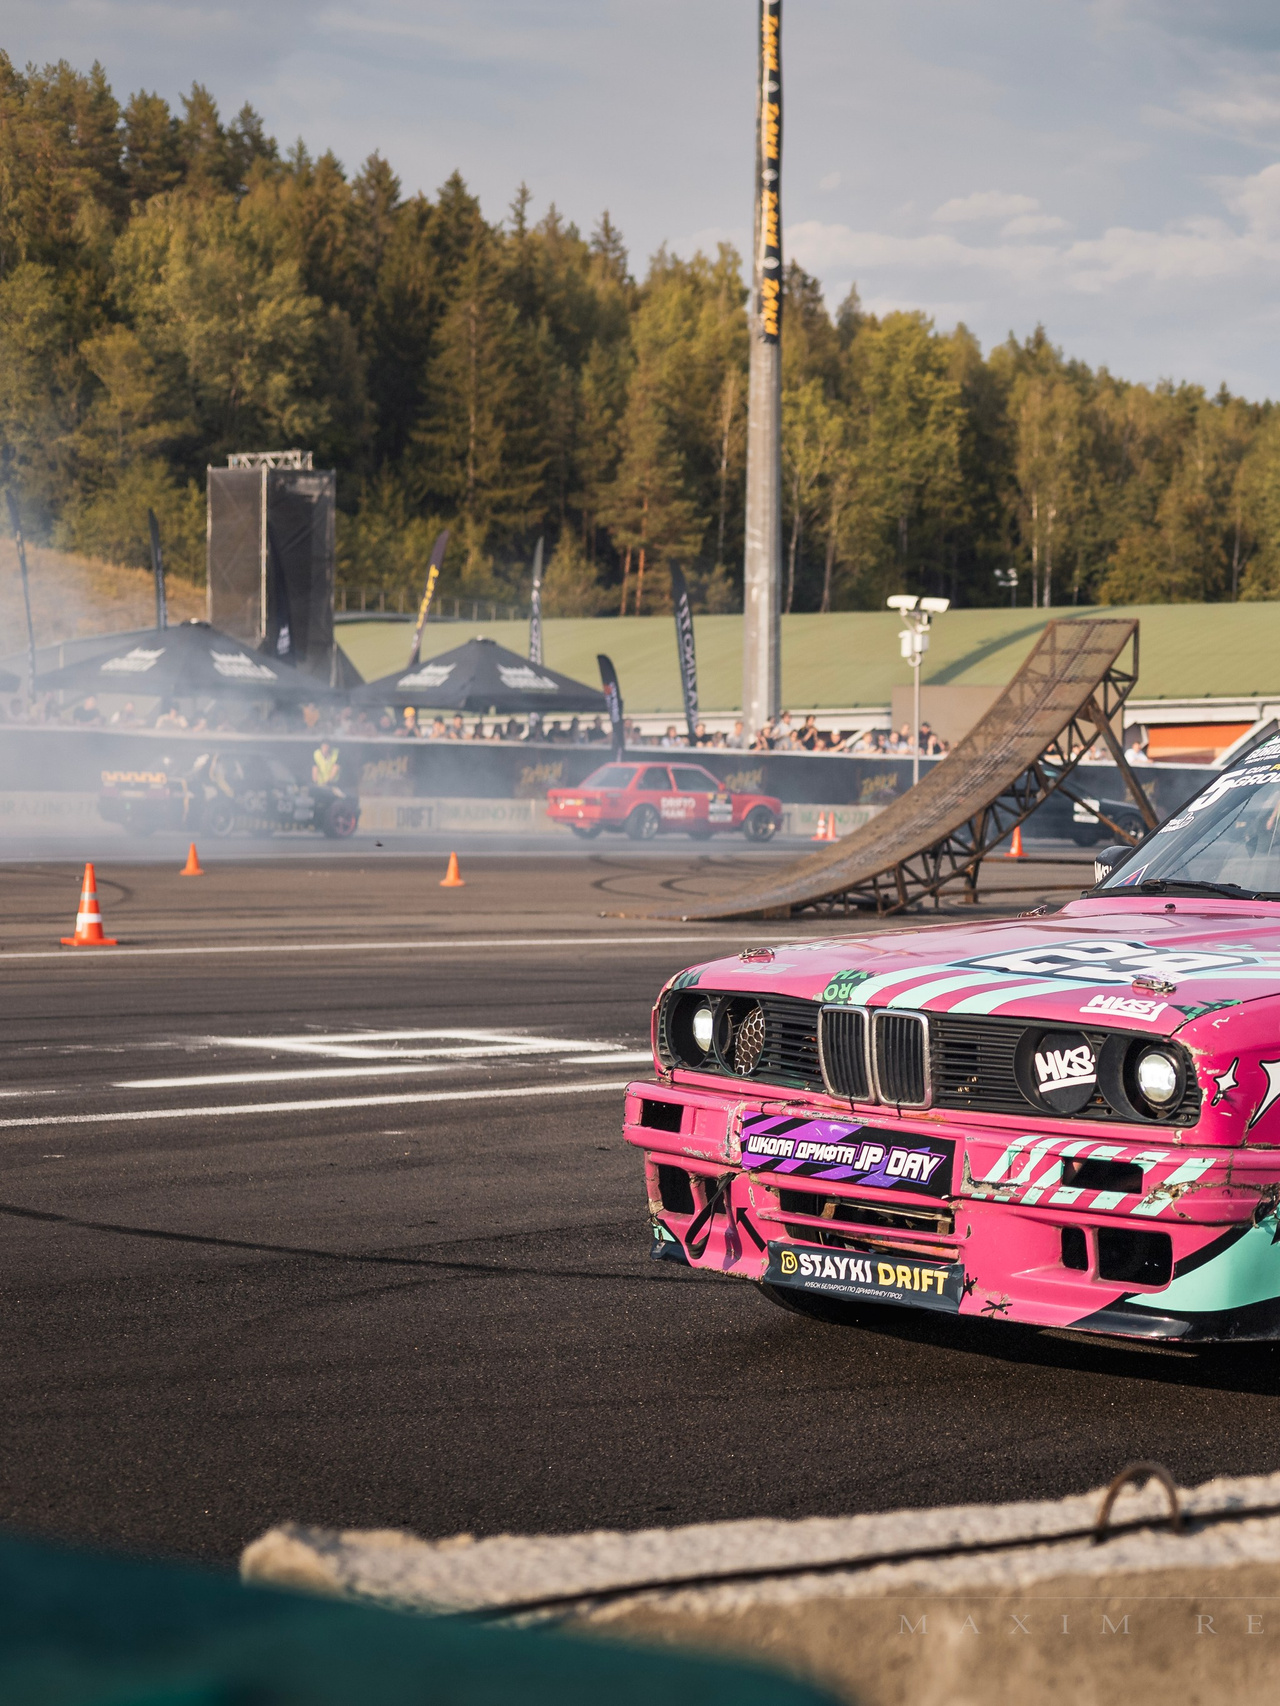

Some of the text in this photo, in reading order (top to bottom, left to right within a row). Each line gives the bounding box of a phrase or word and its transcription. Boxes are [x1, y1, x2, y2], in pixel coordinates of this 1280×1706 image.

[1188, 768, 1247, 812] 5
[1245, 764, 1270, 774] CUP
[747, 1135, 940, 1181] ШКОЛА ДРИФТА JP DAY
[799, 1253, 949, 1295] STAYKI DRIFT
[804, 1281, 821, 1289] КУБОК
[820, 1283, 848, 1292] БЕЛАРУСИ
[847, 1285, 855, 1293] ПО
